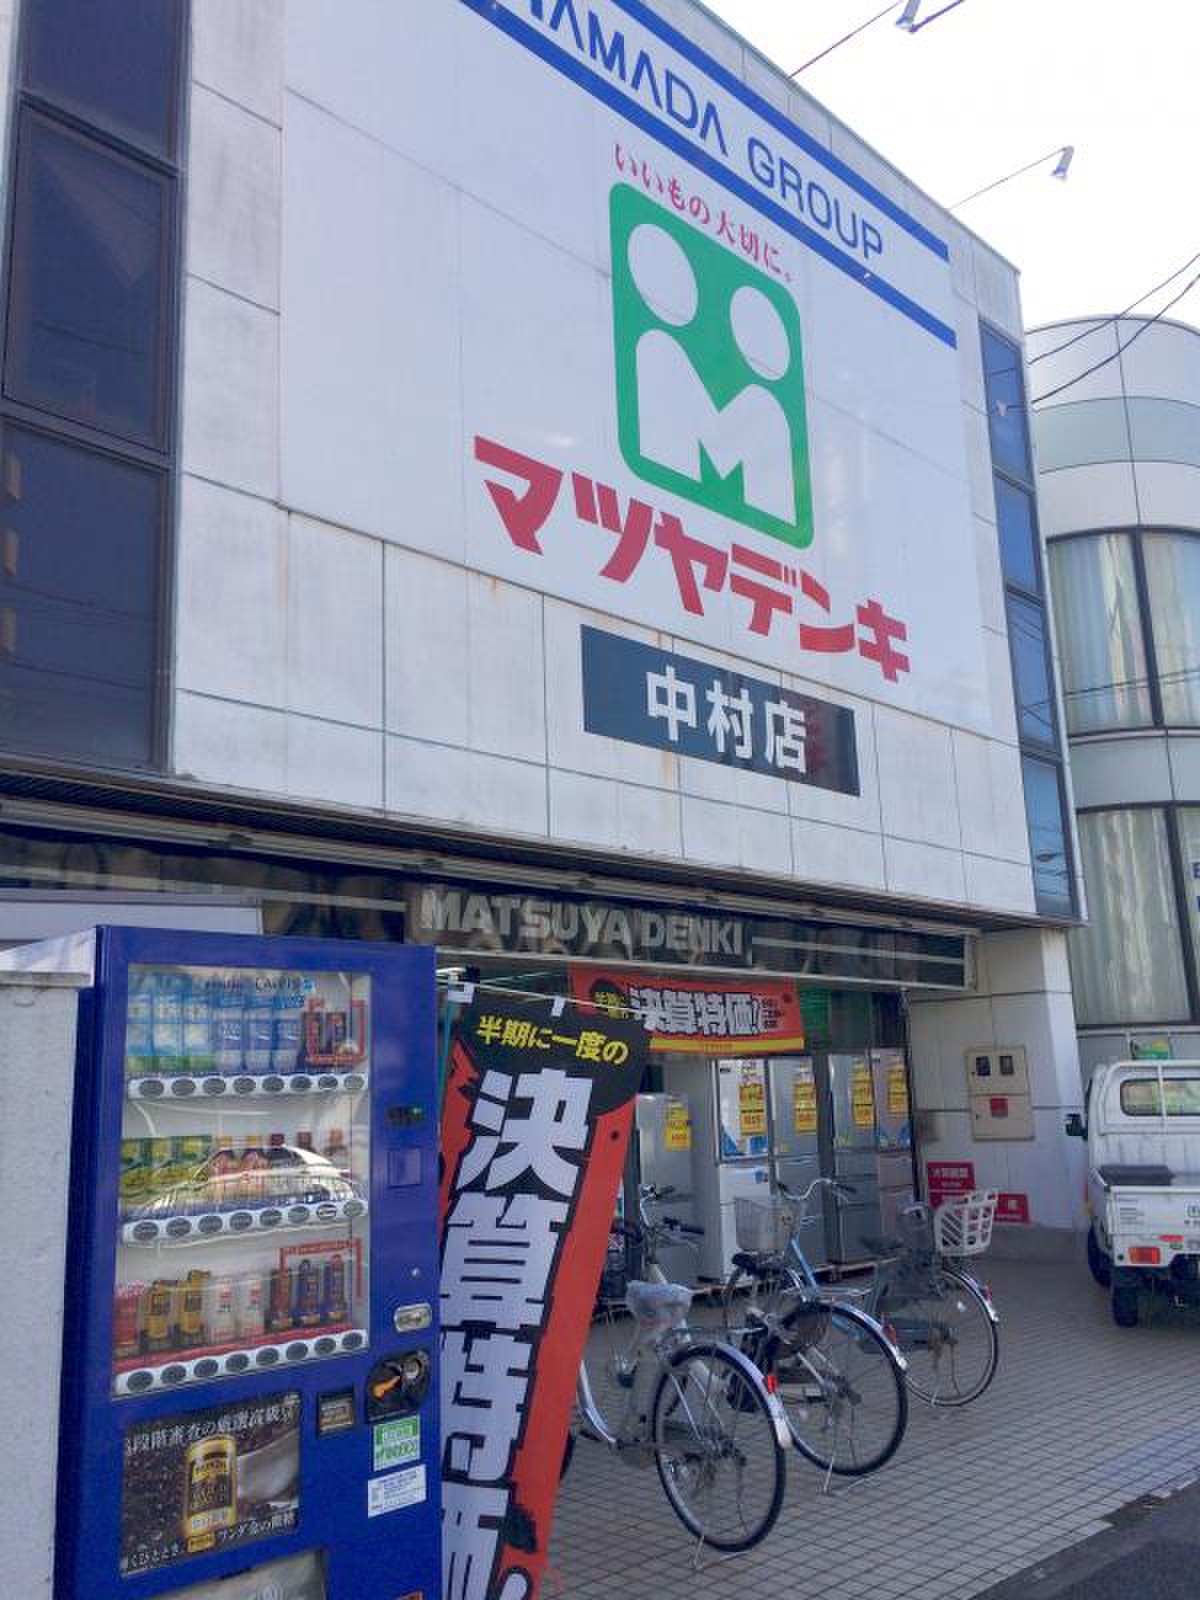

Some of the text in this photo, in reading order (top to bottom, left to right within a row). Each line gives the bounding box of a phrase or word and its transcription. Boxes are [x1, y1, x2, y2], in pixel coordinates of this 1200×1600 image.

[615, 143, 796, 283] いいもの大切に。
[747, 136, 884, 260] GROUP
[474, 435, 911, 683] マツヤデンキ
[645, 665, 807, 774] 中村店
[420, 888, 743, 956] MATSUYA DENKI
[476, 1015, 629, 1065] 半期に一度の
